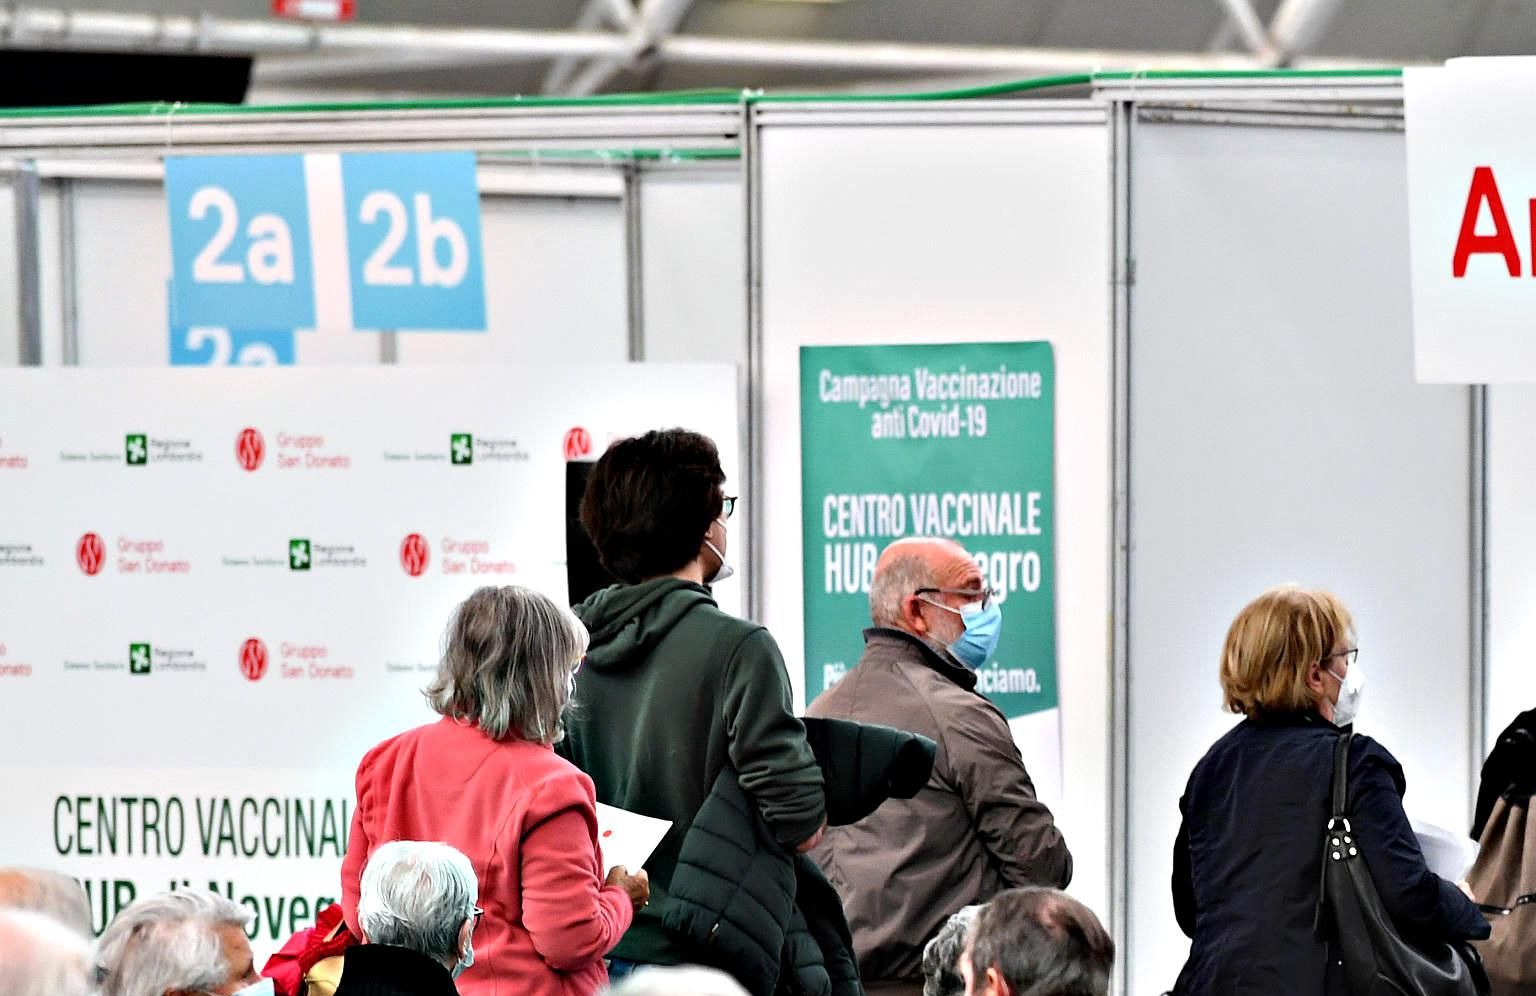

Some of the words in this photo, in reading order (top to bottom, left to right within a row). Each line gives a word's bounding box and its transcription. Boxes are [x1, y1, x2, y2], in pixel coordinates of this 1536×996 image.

[188, 186, 295, 286] 2a
[359, 189, 469, 288] 2b
[819, 368, 911, 409] Campagna
[915, 366, 1042, 401] Vaccinazione
[871, 406, 906, 440] anti
[907, 404, 987, 438] Covid-19
[822, 494, 907, 538] CENTRO
[909, 491, 1042, 537] VACCINALE
[973, 550, 1041, 605] egro
[974, 661, 1042, 694] nciamo.
[53, 795, 186, 856] CENTRO
[195, 797, 350, 859] VACCINAL
